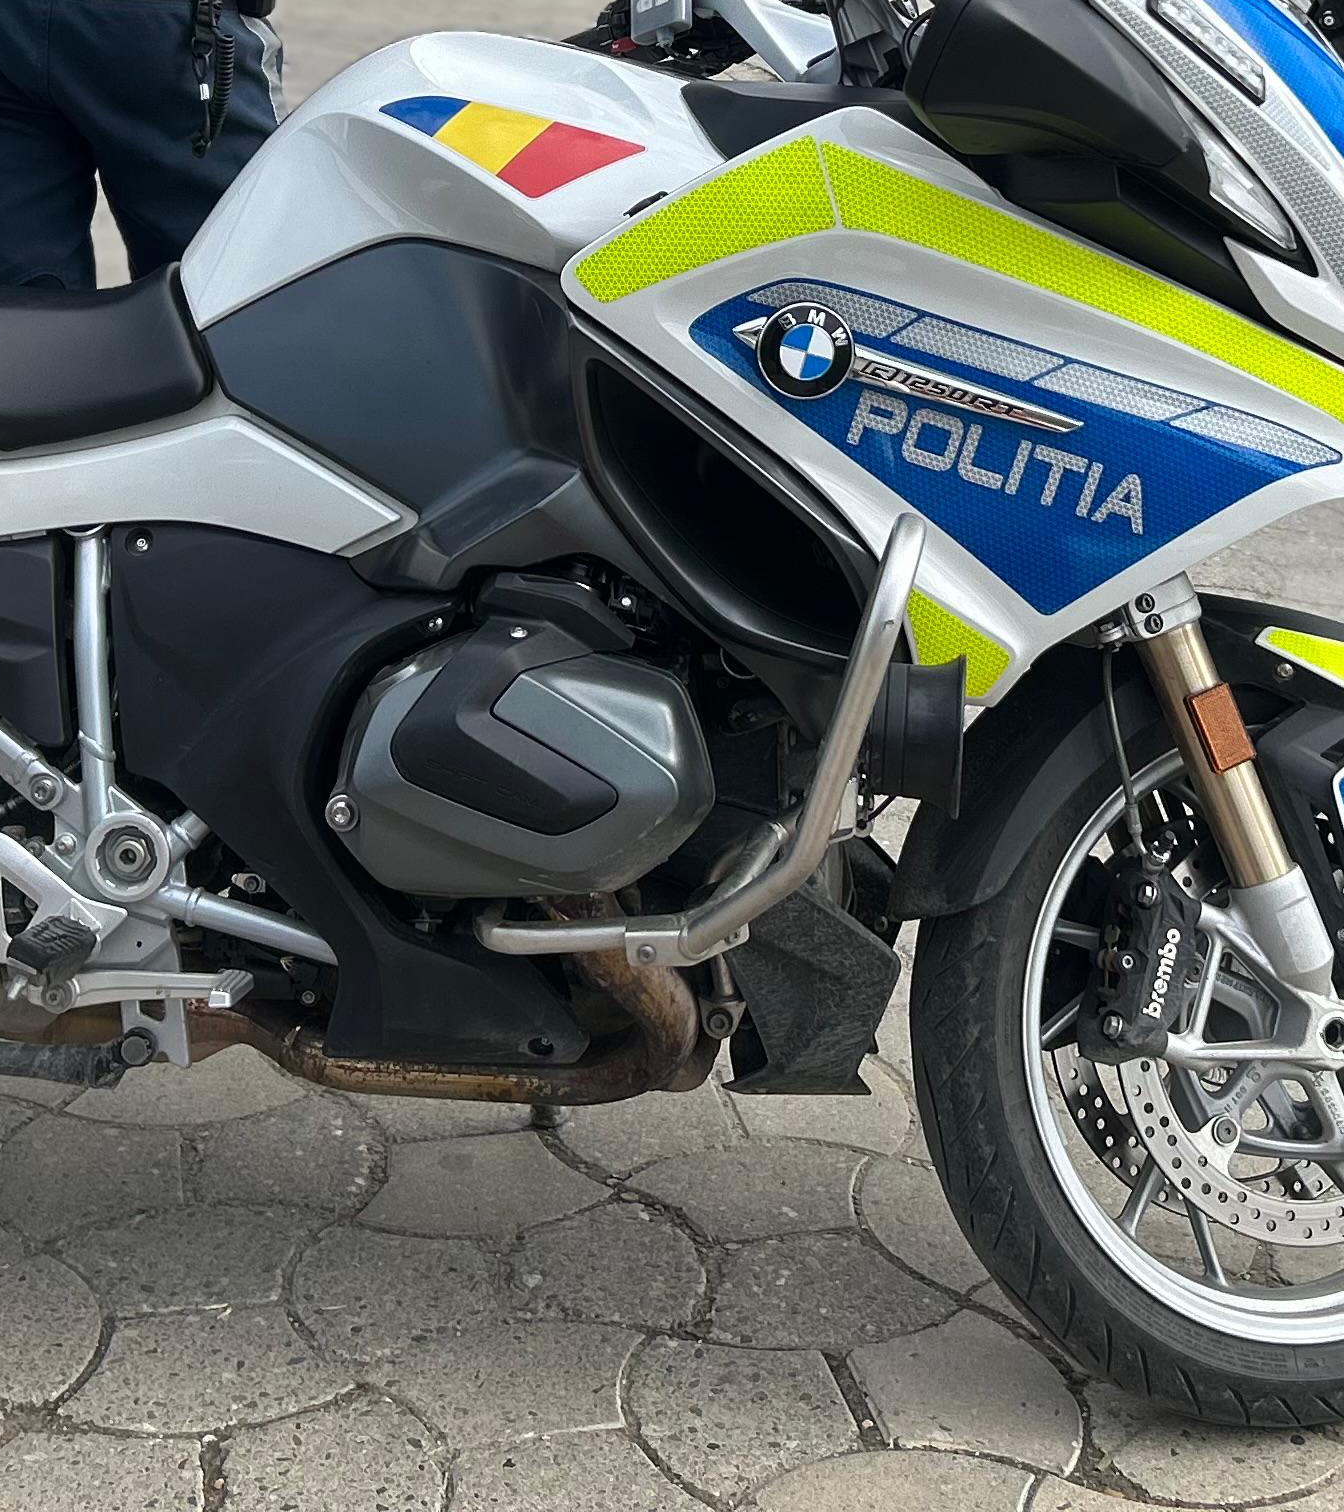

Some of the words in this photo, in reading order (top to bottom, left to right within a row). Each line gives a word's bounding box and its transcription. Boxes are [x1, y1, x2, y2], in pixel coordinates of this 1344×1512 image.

[777, 307, 849, 348] BMW
[845, 388, 1144, 536] POLITIA
[1142, 928, 1181, 1020] brembo
